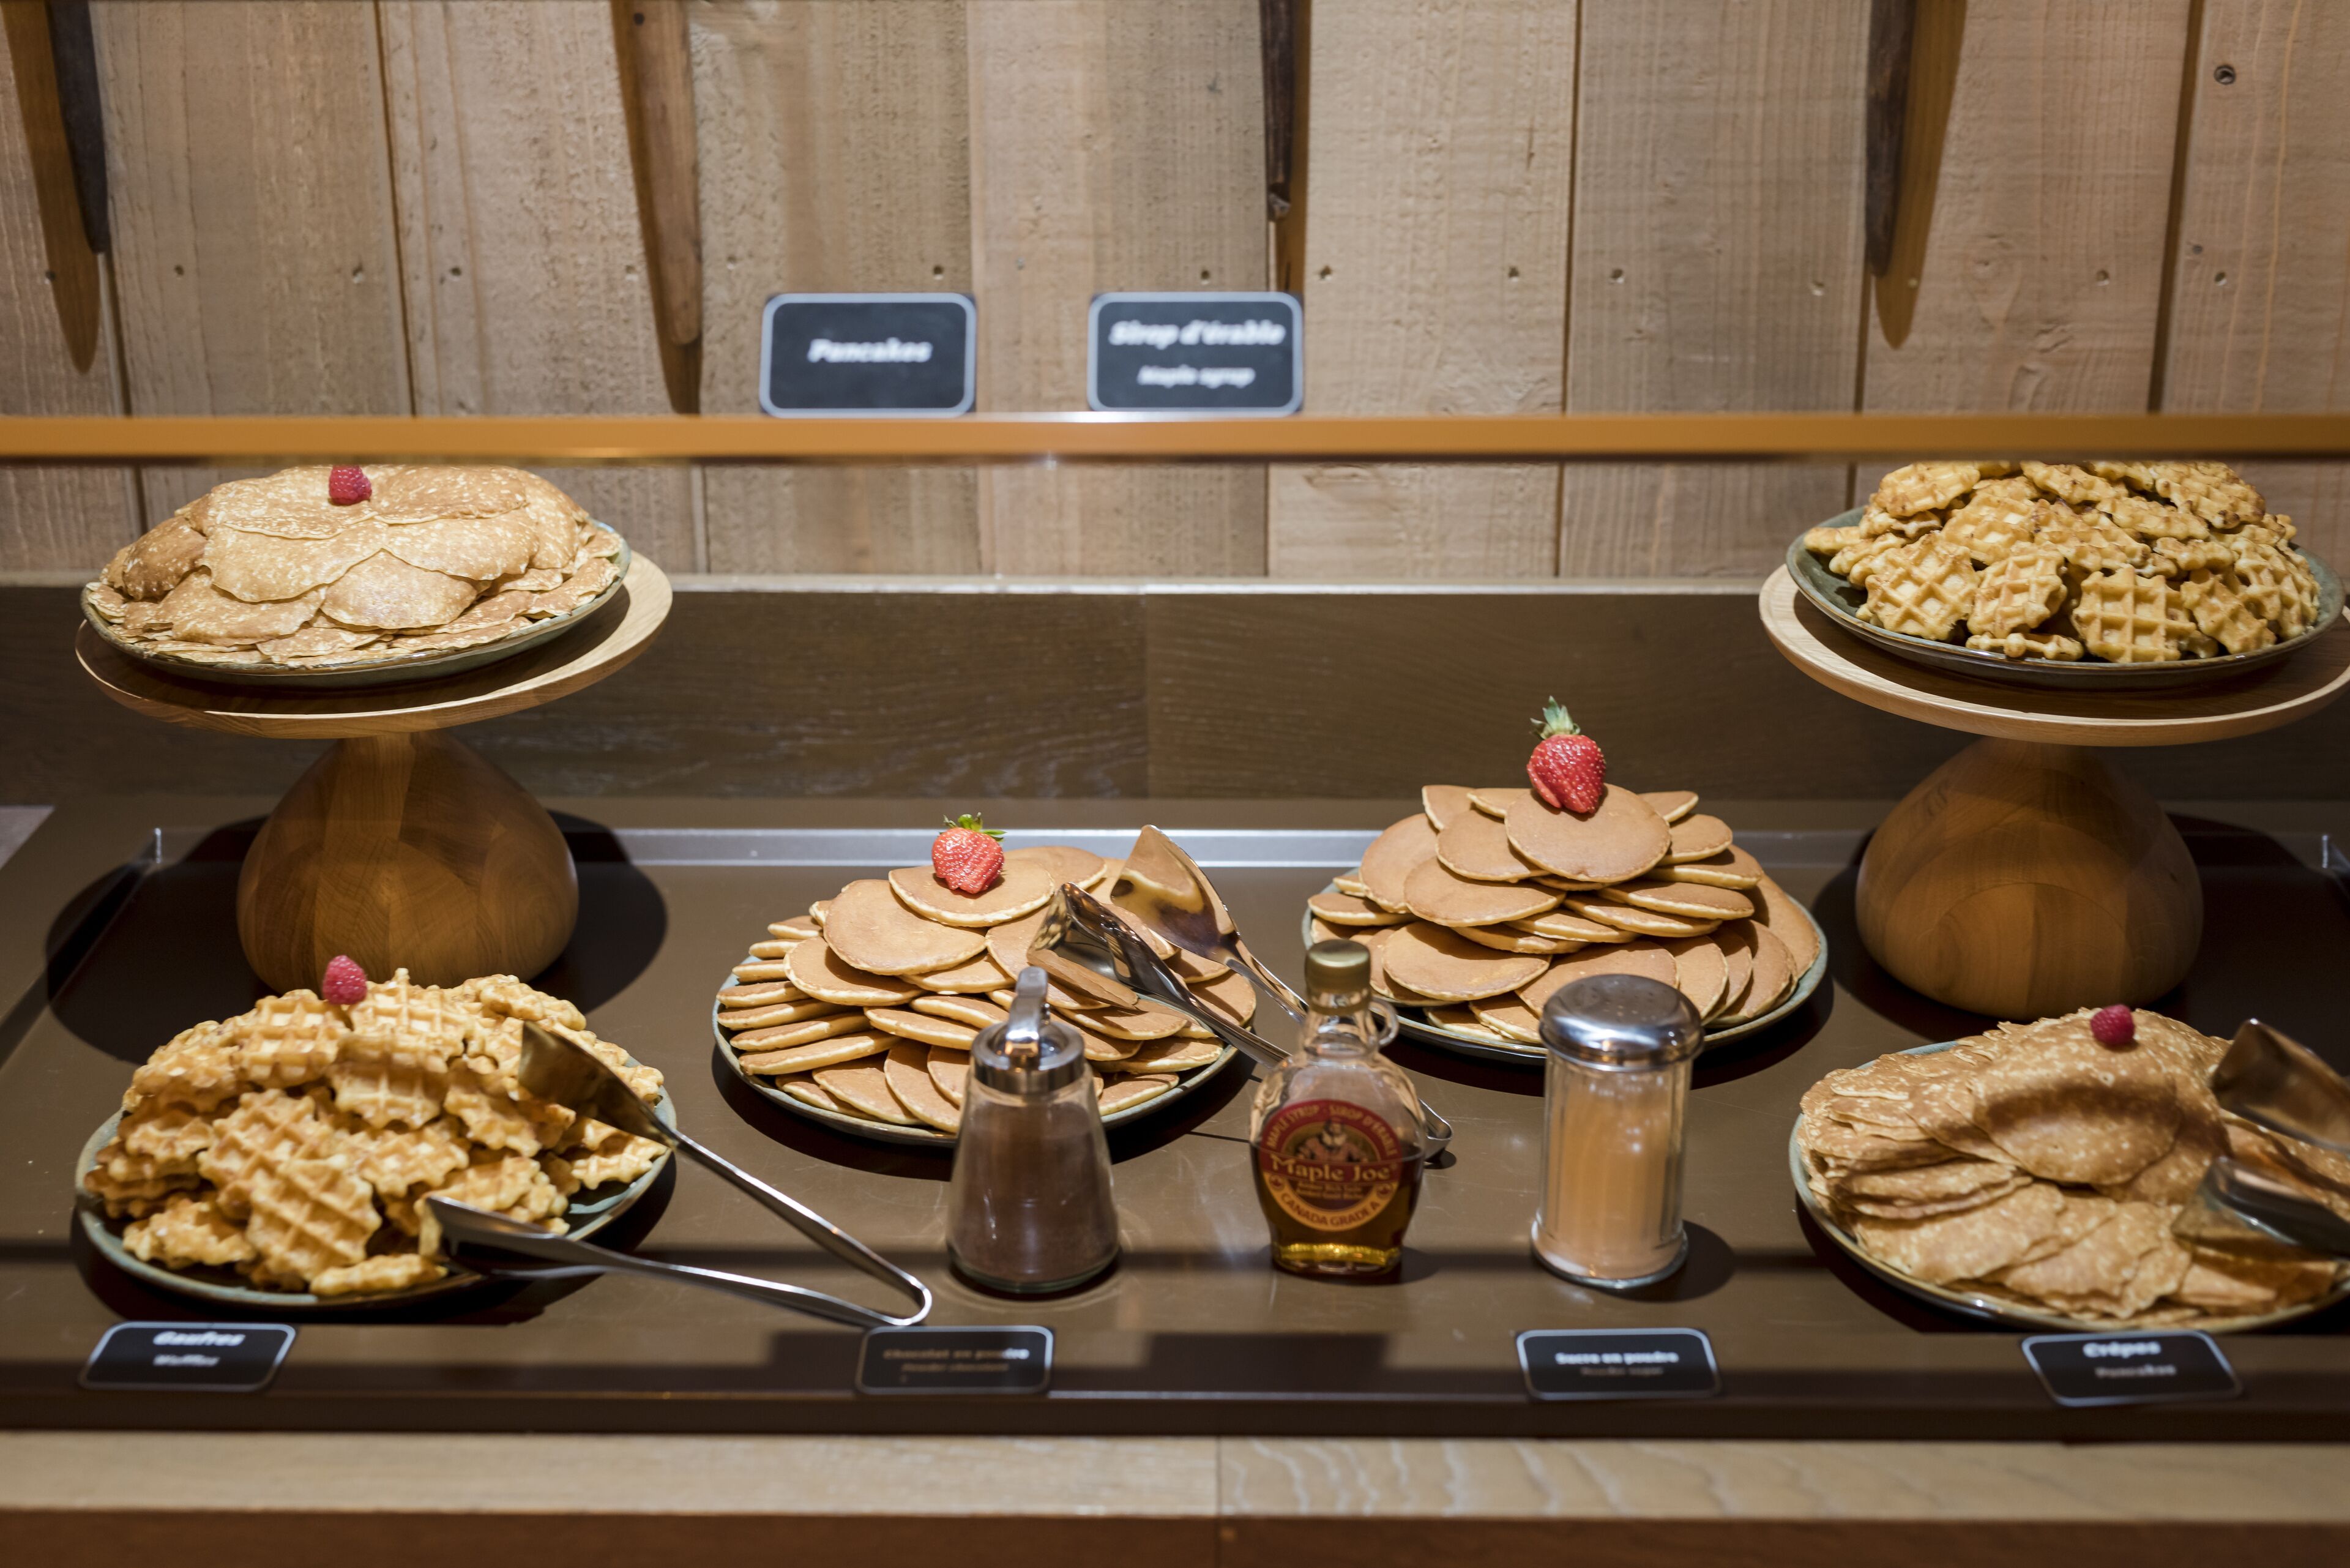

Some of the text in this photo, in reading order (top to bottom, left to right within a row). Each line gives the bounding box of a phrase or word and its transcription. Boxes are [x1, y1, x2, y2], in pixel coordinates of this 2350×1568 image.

[808, 337, 932, 362] Pancakes
[1270, 1153, 1390, 1182] Maple Joe
[1281, 1193, 1327, 1225] CANADA
[1370, 1201, 1381, 1211] A
